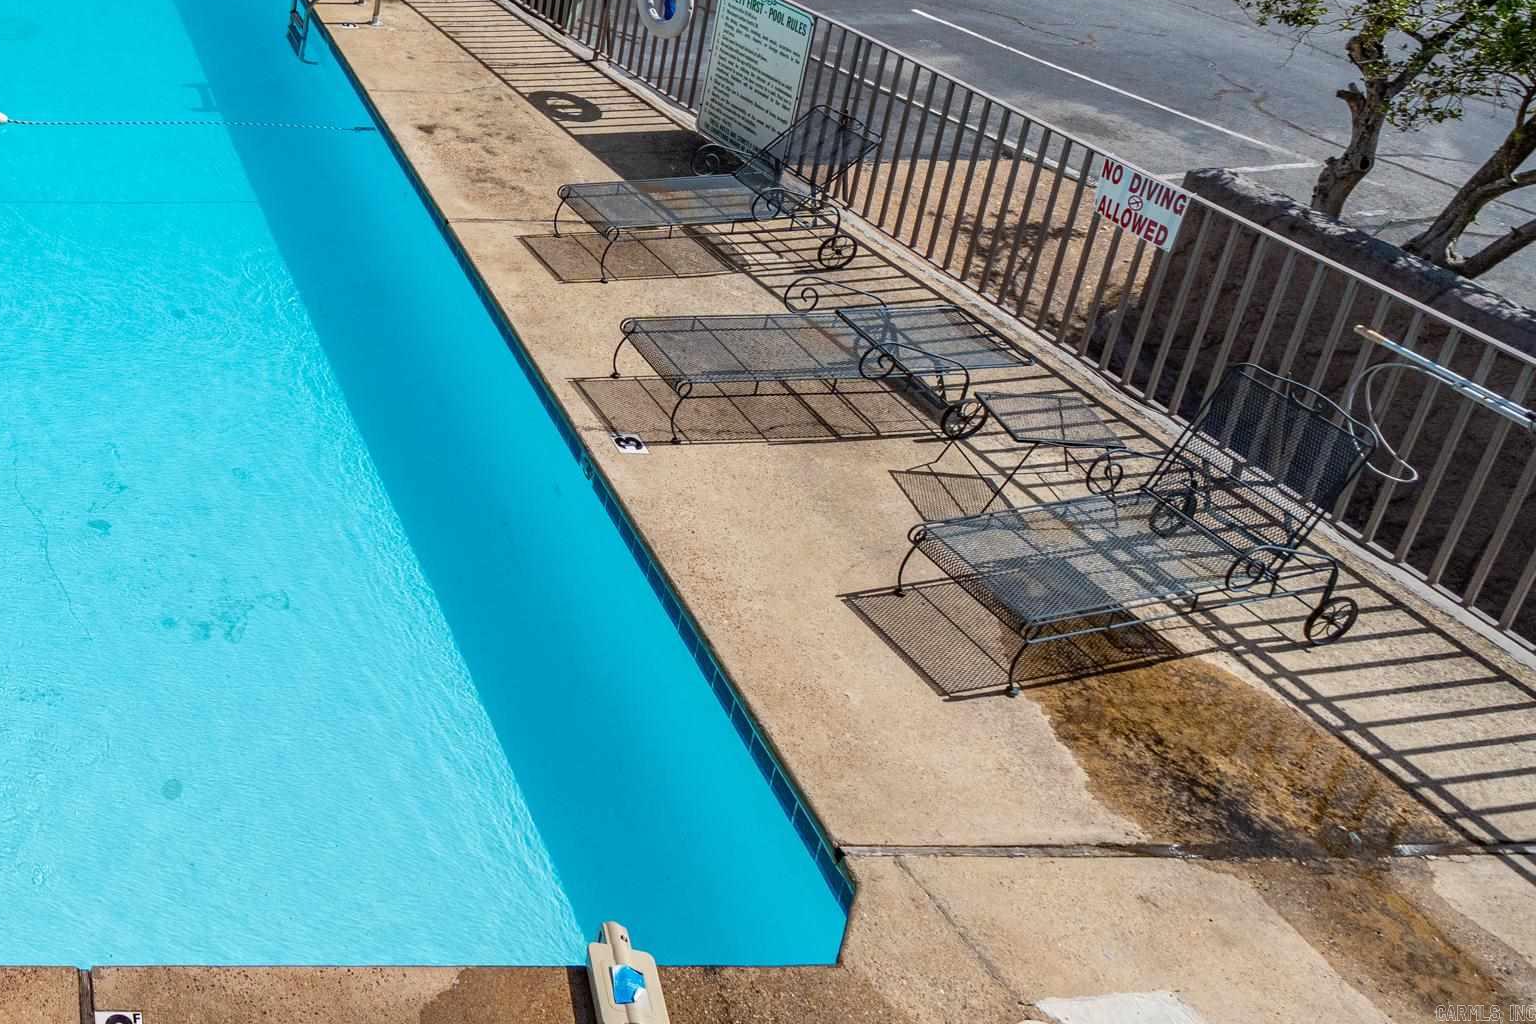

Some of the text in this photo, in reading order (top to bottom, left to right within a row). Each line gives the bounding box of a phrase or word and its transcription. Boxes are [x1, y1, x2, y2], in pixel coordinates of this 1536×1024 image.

[768, 7, 785, 26] POOL
[786, 16, 808, 37] RULES
[1102, 159, 1187, 217] NO DIVING
[1097, 195, 1169, 246] ALLOWED
[614, 437, 643, 450] 3
